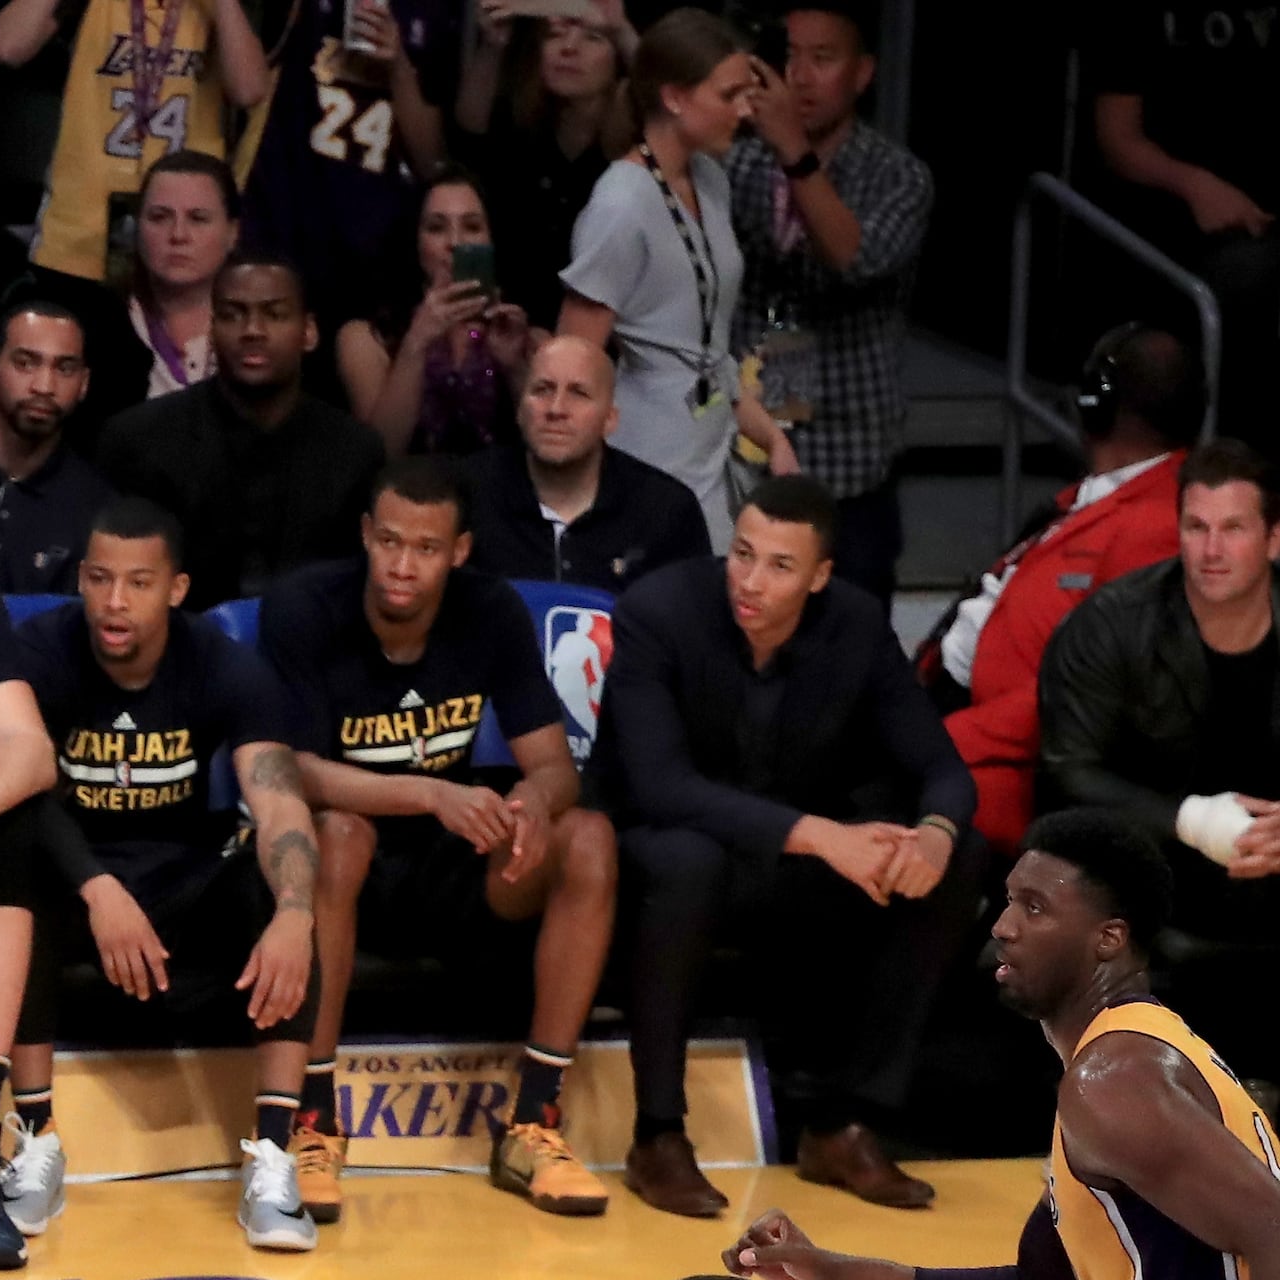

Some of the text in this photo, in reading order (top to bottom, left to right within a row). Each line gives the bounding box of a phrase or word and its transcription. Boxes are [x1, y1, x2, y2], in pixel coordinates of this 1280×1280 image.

[104, 88, 188, 158] 24
[309, 82, 394, 174] 24
[342, 693, 483, 746] UTAH JAZZ
[346, 1055, 401, 1074] LOS
